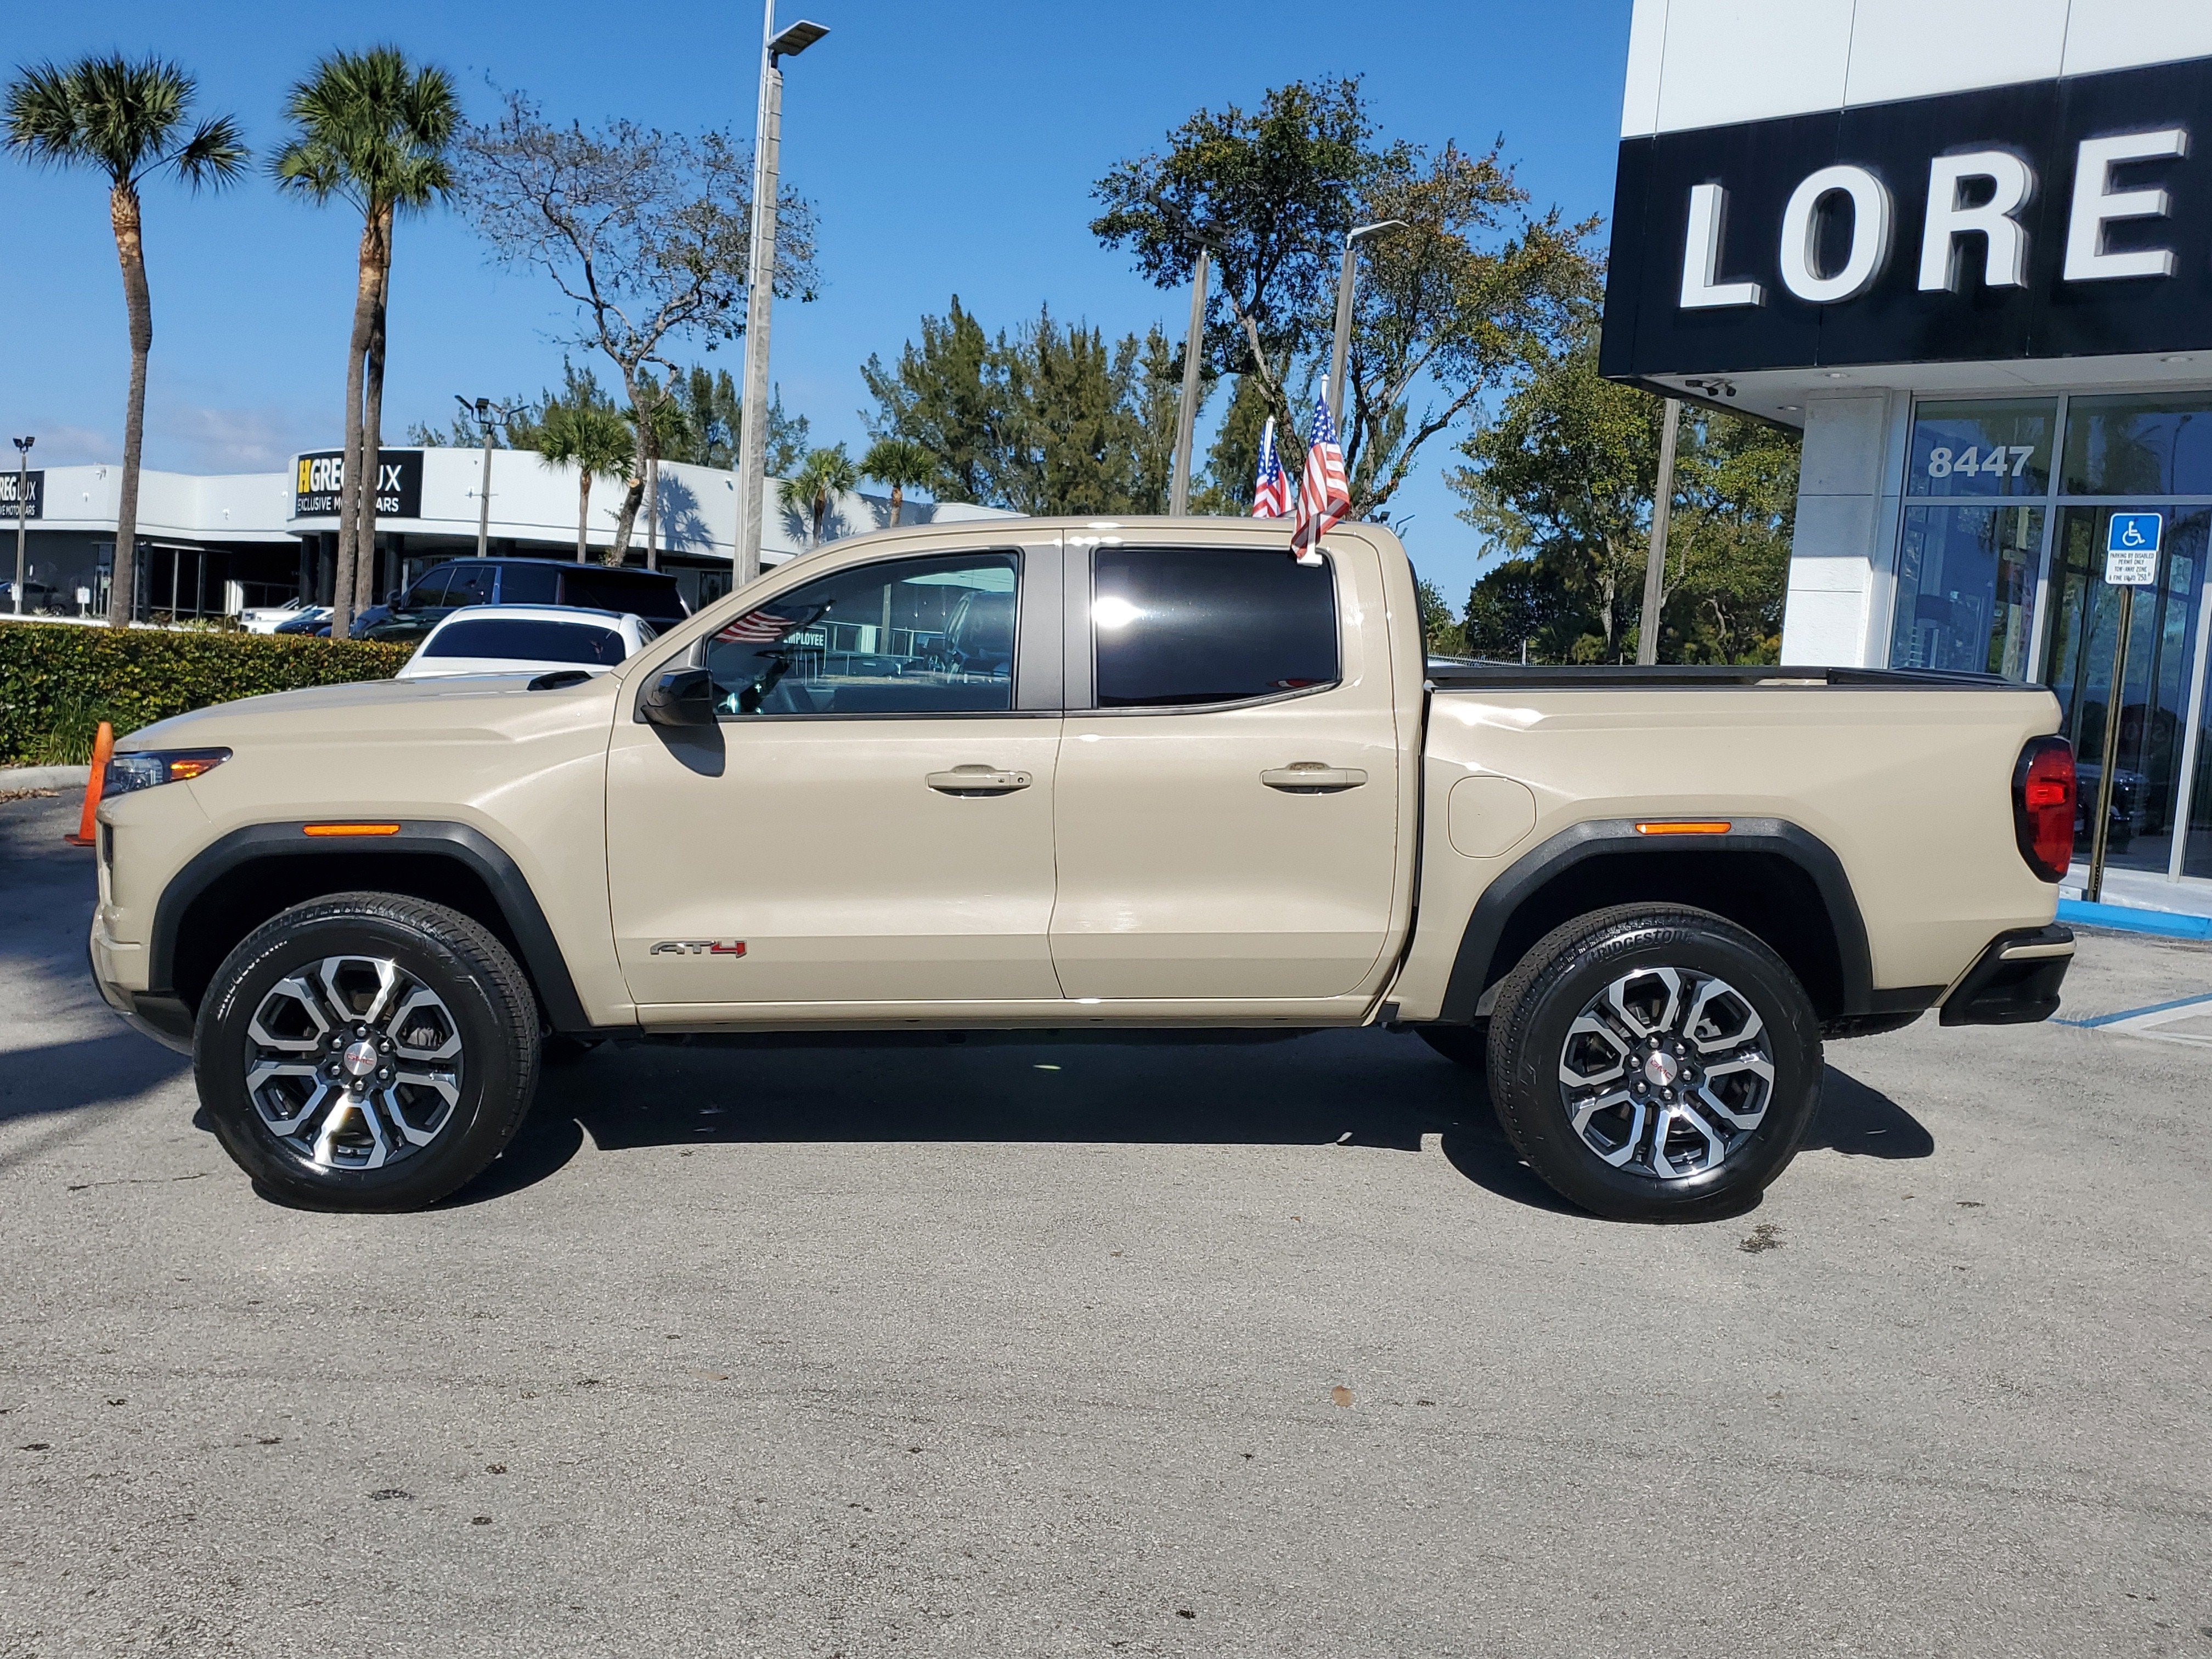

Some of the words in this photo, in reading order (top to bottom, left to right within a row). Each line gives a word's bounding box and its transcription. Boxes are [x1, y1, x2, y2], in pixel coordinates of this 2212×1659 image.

[1680, 128, 2187, 309] LORE
[298, 458, 345, 493] HGRE
[1928, 446, 2034, 478] 8447
[297, 496, 331, 511] EXCLUSIVE
[650, 940, 747, 958] AT4
[1650, 1058, 1673, 1080] GMC
